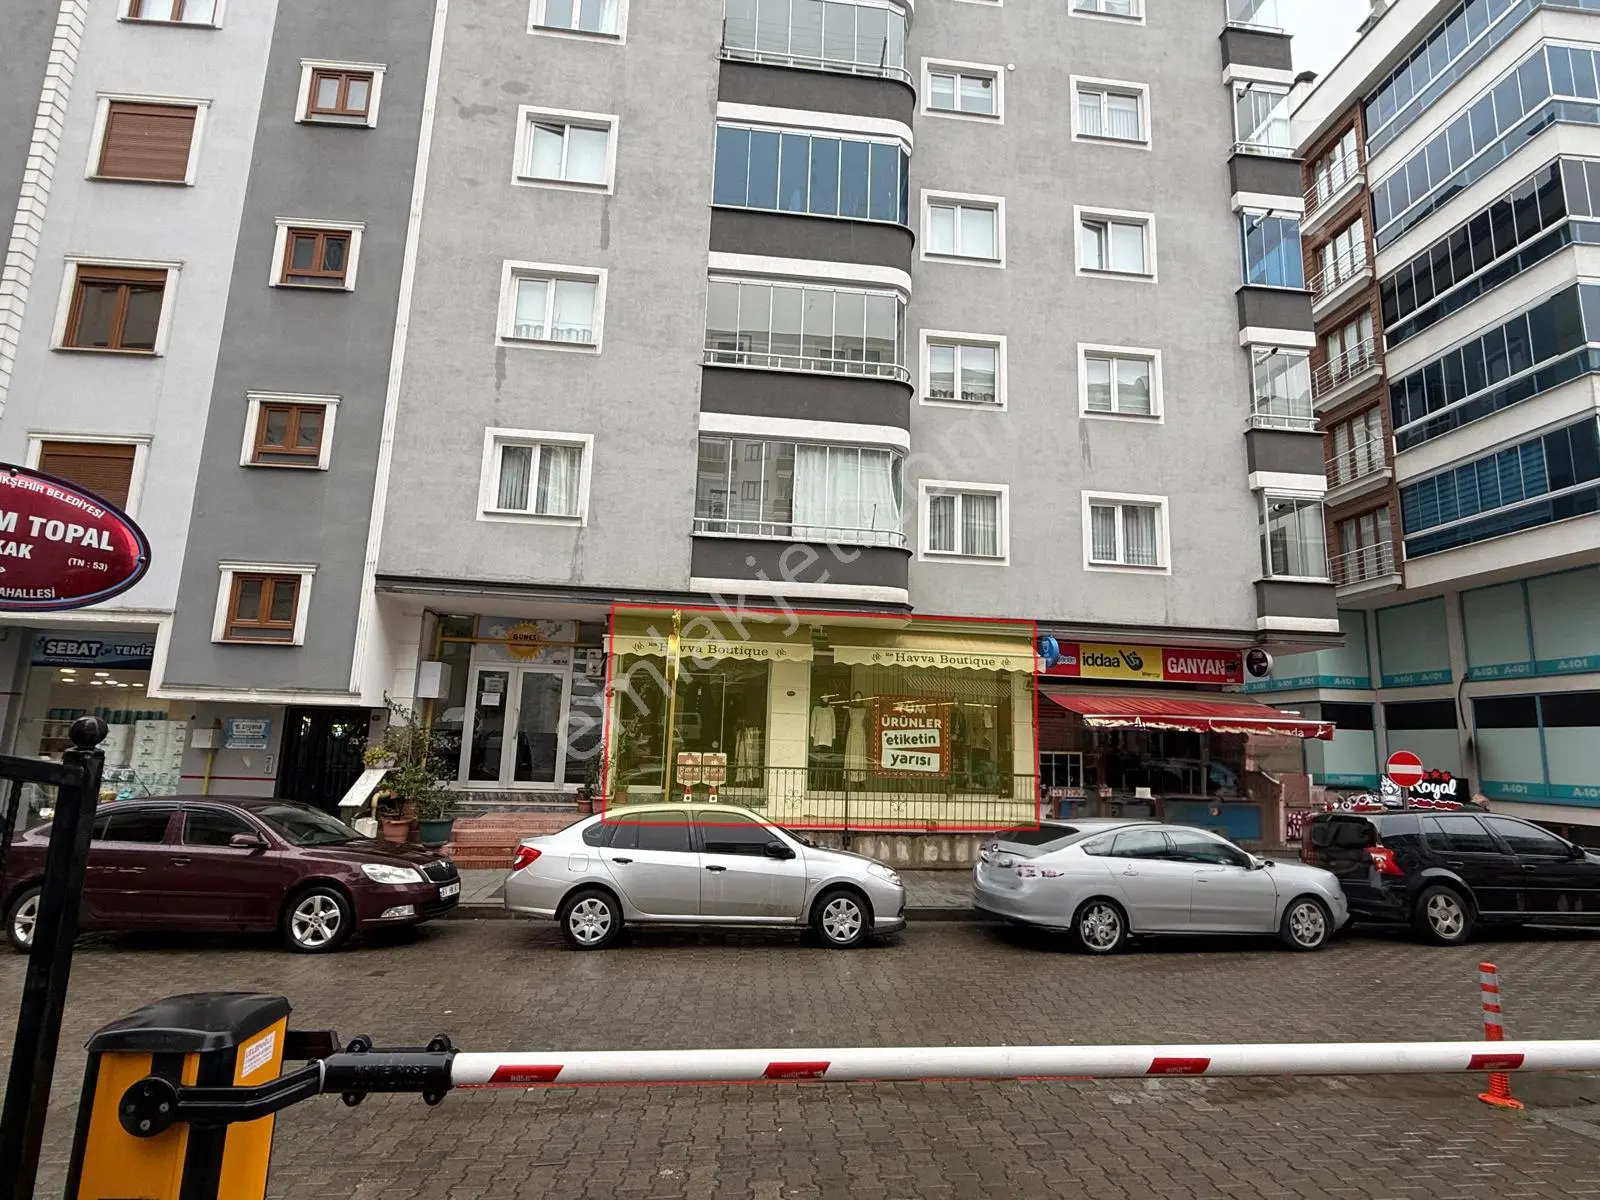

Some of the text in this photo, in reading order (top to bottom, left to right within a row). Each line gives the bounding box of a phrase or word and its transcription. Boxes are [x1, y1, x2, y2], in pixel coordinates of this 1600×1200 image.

[46, 488, 105, 518] BELEDİYESİ
[29, 516, 114, 551] TOPAL
[46, 640, 101, 656] SEBAT
[707, 644, 769, 657] Boutique
[895, 652, 996, 667] Havva Boutique
[1082, 652, 1120, 668] iddaa
[1167, 656, 1226, 676] GANYAN
[881, 714, 942, 729] ÜRÜNLER
[886, 733, 936, 746] etiketin
[890, 753, 931, 767] yarısı
